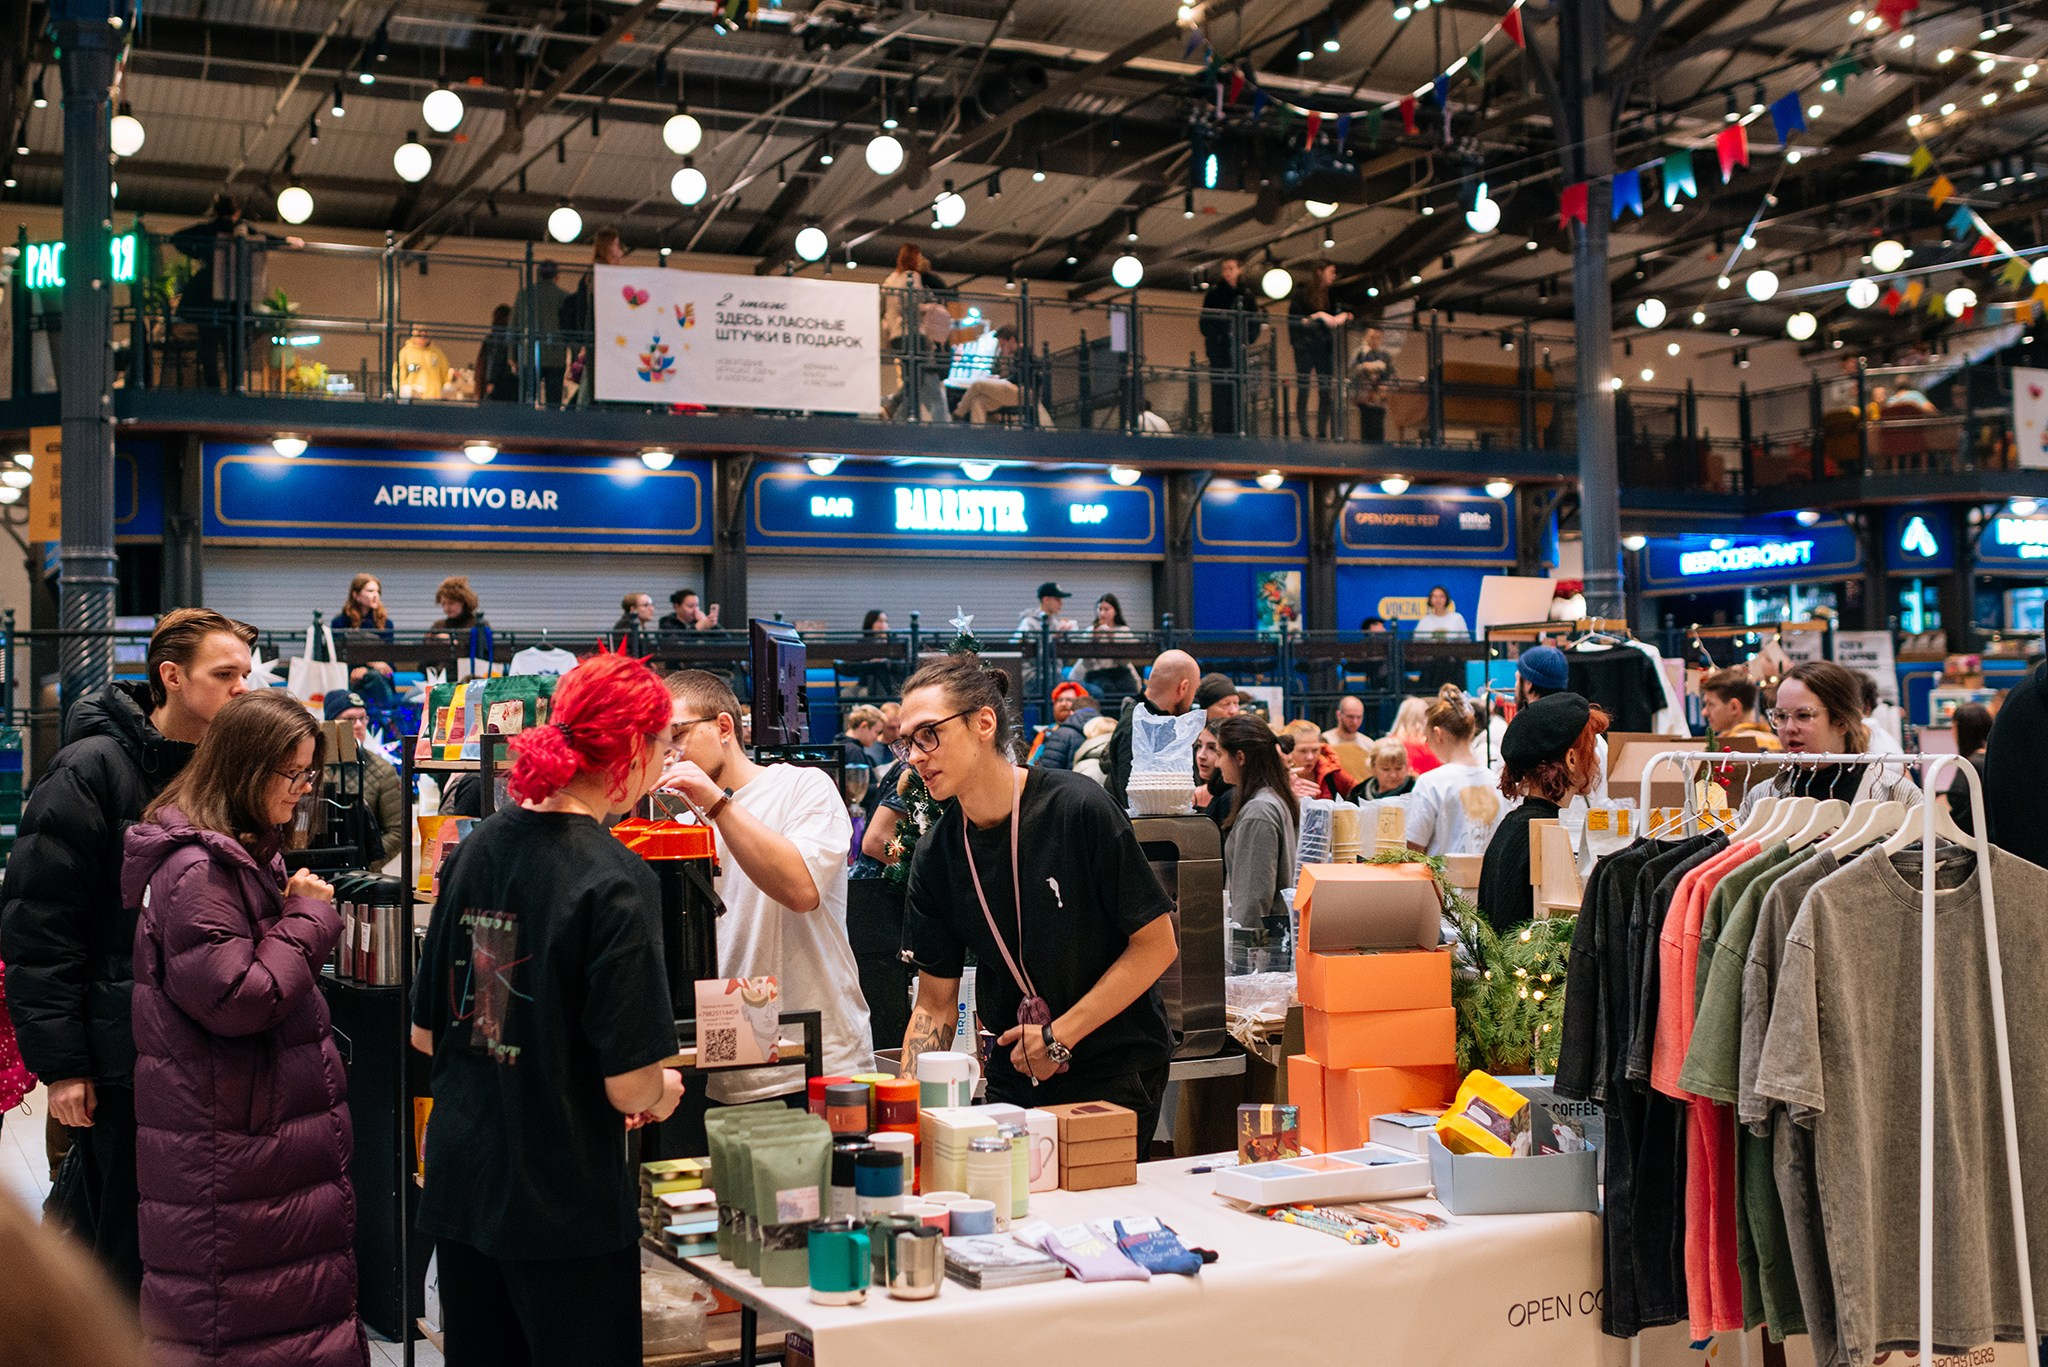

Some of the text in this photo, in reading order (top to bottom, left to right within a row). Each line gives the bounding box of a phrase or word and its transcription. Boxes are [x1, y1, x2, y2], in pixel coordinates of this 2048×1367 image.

[715, 311, 846, 331] ЗДЕСЬ КЛАССНЫЕ
[715, 328, 863, 348] ШТУЧКИ В ПОДАРОК
[374, 485, 559, 510] APERITIVO BAR
[811, 496, 853, 517] BAR
[895, 487, 1028, 532] BARRISTER
[1355, 512, 1440, 527] OPEN COFFEE FEST
[1552, 1103, 1598, 1116] COFFEE
[1508, 1293, 1572, 1327] OPEN
